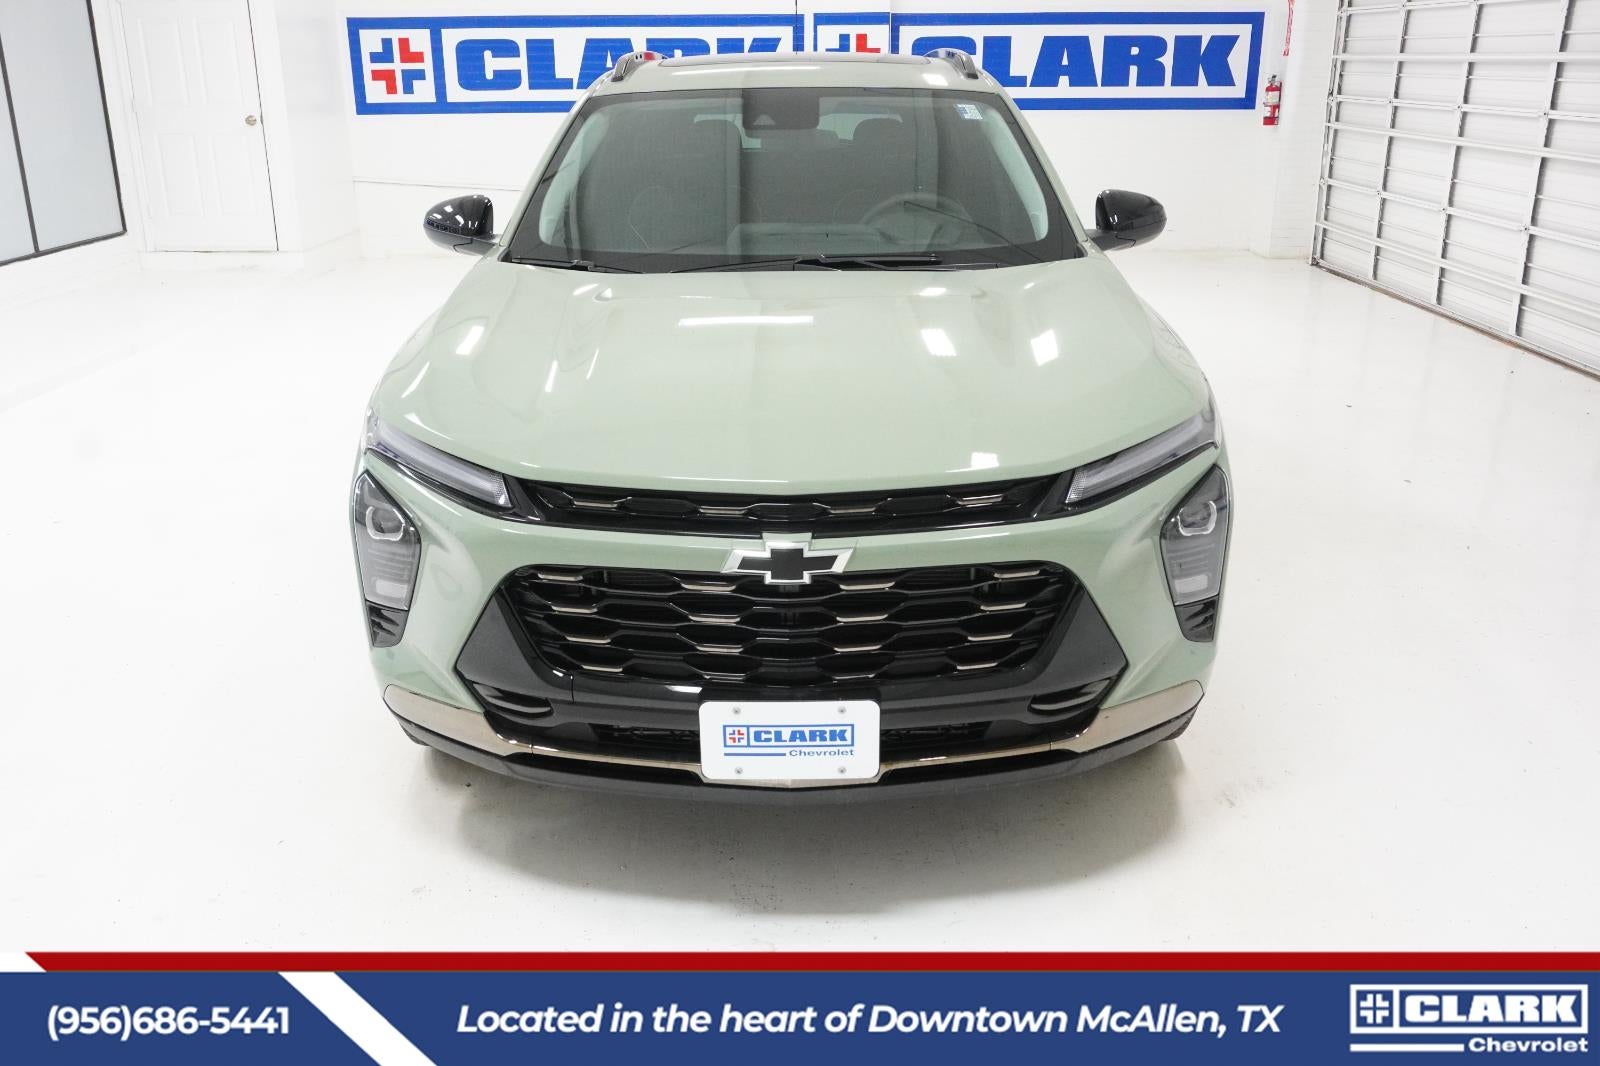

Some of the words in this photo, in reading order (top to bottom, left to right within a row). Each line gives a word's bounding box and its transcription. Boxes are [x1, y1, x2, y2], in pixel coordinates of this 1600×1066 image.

[455, 37, 782, 91] CLA
[753, 728, 848, 743] CLARK
[788, 749, 854, 757] Chevrolet
